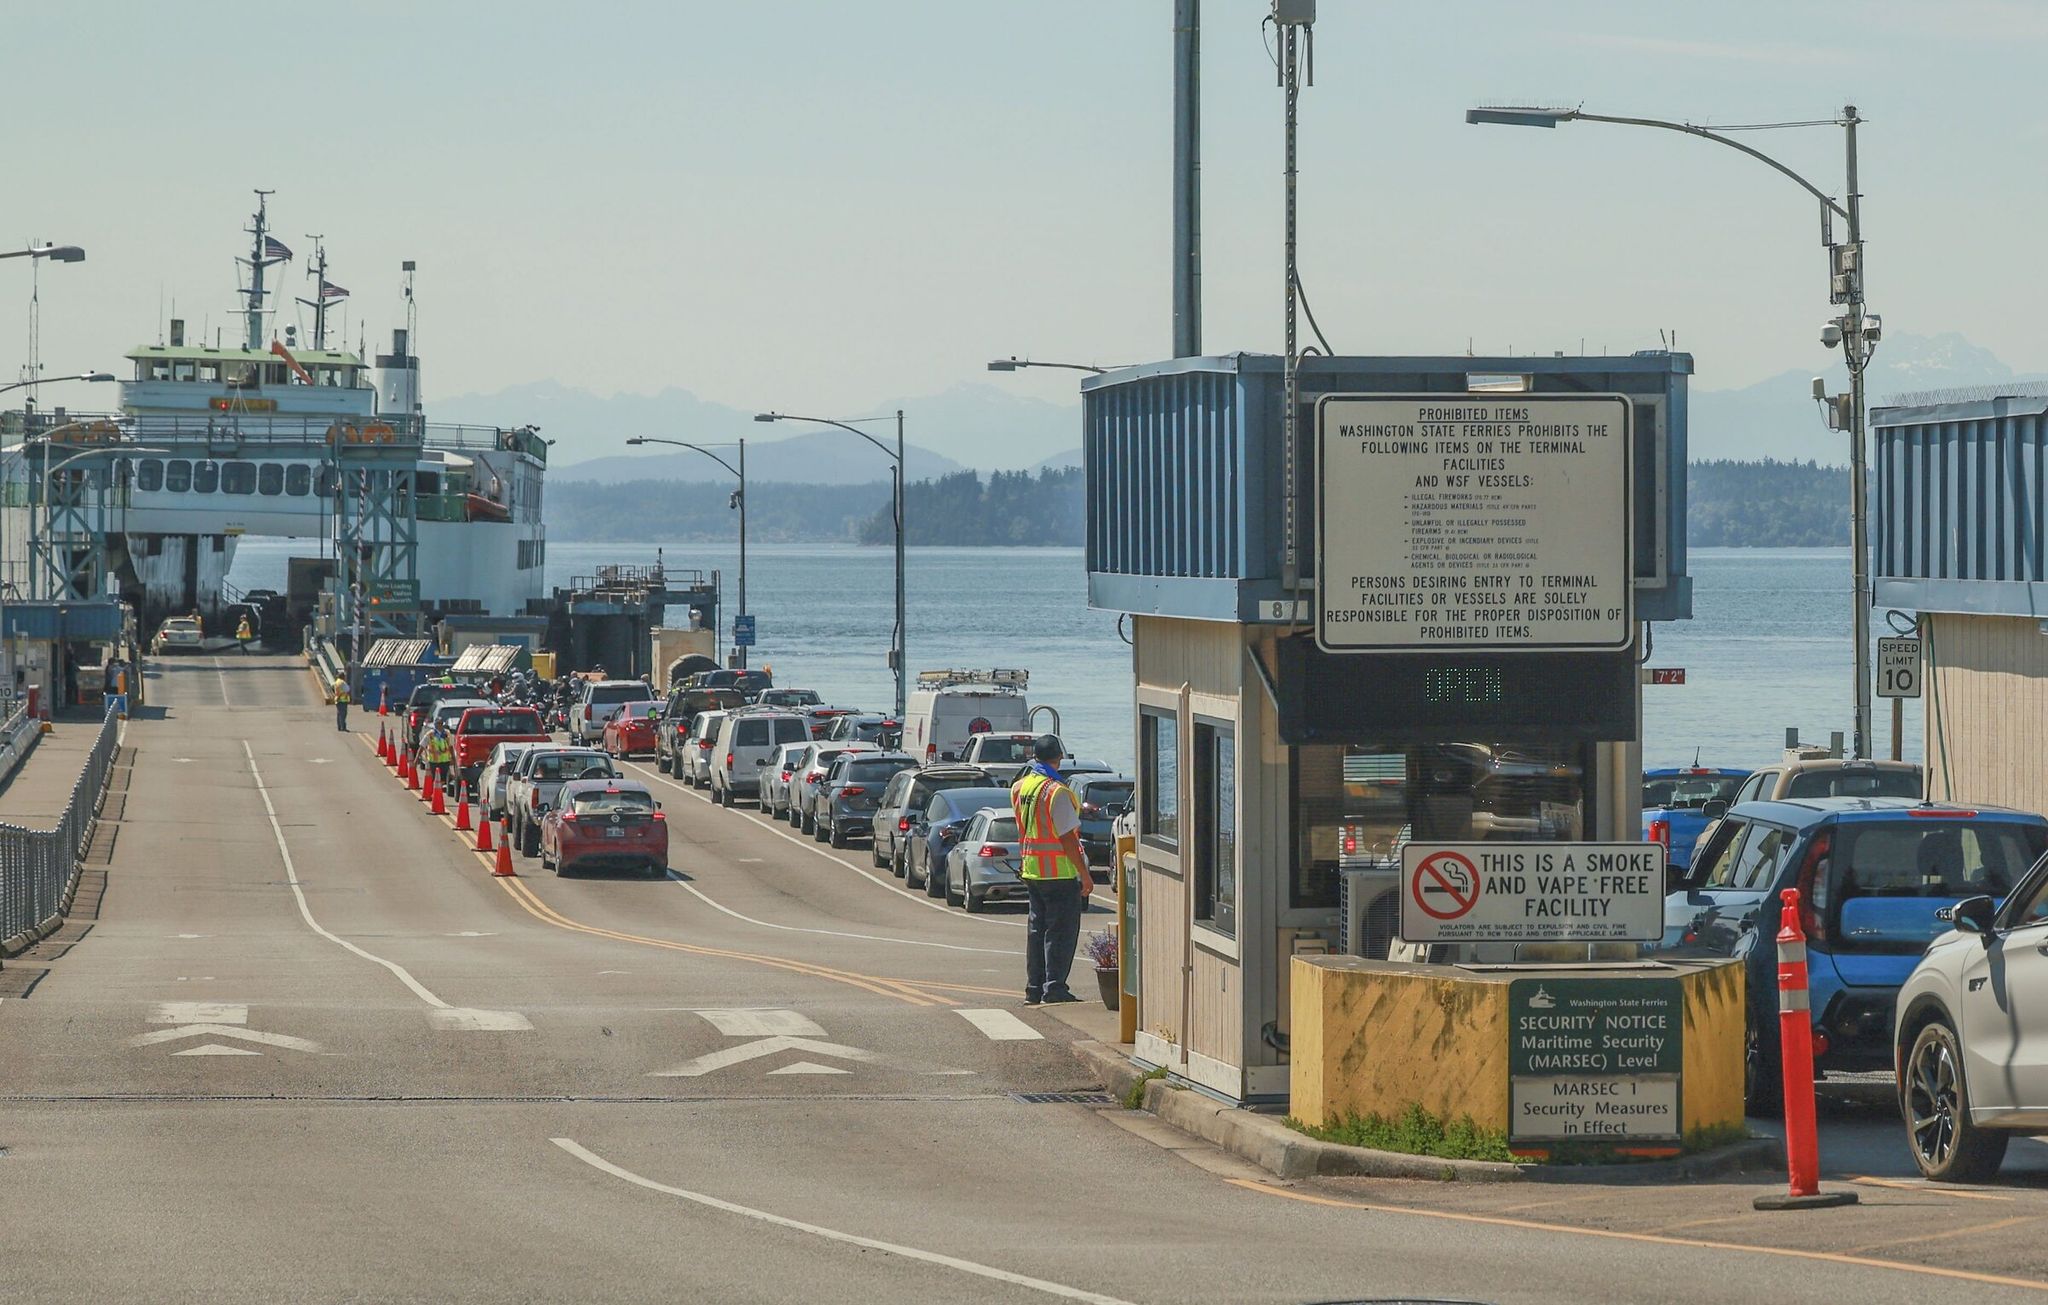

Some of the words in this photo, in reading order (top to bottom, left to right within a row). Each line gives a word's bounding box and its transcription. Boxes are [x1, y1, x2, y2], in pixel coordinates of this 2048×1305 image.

[1420, 408, 1487, 420] PROHIBITED
[1496, 408, 1528, 420] ITEMS
[1340, 425, 1413, 436] WASHINGTON
[1422, 425, 1454, 437] STATE
[1464, 425, 1510, 436] FERRIES
[1519, 425, 1578, 436] PROHIBITS
[1587, 425, 1607, 436] THE
[1362, 442, 1428, 454] FOLLOWING
[1436, 442, 1468, 454] ITEMS
[1477, 442, 1492, 453] ON
[1500, 442, 1520, 453] THE
[1530, 442, 1585, 453] TERMINAL
[1444, 459, 1504, 470] FACILITIES
[1416, 476, 1438, 487] AND
[1446, 476, 1470, 487] WSF
[1478, 475, 1533, 487] VESSELS:
[1352, 576, 1405, 588] PERSONS
[1413, 576, 1466, 588] DESIRING
[1475, 576, 1510, 587] ENTRY
[1520, 576, 1533, 588] TO
[1542, 576, 1597, 587] TERMINAL
[1362, 593, 1423, 605] FACILITIES
[1432, 593, 1446, 604] OR
[1455, 593, 1506, 604] VESSELS
[1514, 593, 1536, 604] ARE
[1544, 592, 1586, 604] SOLELY
[1327, 610, 1407, 622] RESPONSIBLE
[1416, 610, 1437, 621] FOR
[1446, 610, 1466, 621] THE
[1475, 609, 1520, 621] PROPER
[1528, 609, 1600, 620] DISPOSITION
[1608, 609, 1621, 620] OF
[1421, 626, 1488, 638] PROHIBITED
[1497, 626, 1532, 637] ITEMS.
[1882, 644, 1918, 652] SPEED
[1886, 657, 1914, 665] LIMIT
[1426, 668, 1501, 701] OPEN
[1886, 669, 1912, 690] 10
[1480, 854, 1524, 872] THIS
[1536, 854, 1552, 872] IS
[1563, 854, 1576, 872] A
[1587, 854, 1654, 872] SMOKE
[1485, 876, 1526, 894] AND
[1538, 877, 1588, 894] VAPE
[1601, 876, 1649, 894] FREE
[1525, 898, 1611, 917] FACILITY
[1940, 909, 1952, 918] KI
[1570, 1000, 1616, 1008] Washington
[1520, 1016, 1595, 1029] SECURITY
[1606, 1016, 1666, 1028] NOTICE
[1522, 1035, 1592, 1048] Maritime
[1603, 1035, 1664, 1051] Security
[1529, 1054, 1607, 1070] (MARSEC)
[1619, 1054, 1656, 1067] Level
[1554, 1082, 1618, 1095] MARSEC
[1631, 1082, 1635, 1094] 1
[1524, 1102, 1584, 1119] Security
[1596, 1102, 1667, 1114] Measures
[1564, 1121, 1577, 1134] in
[1584, 1121, 1626, 1134] Effect
